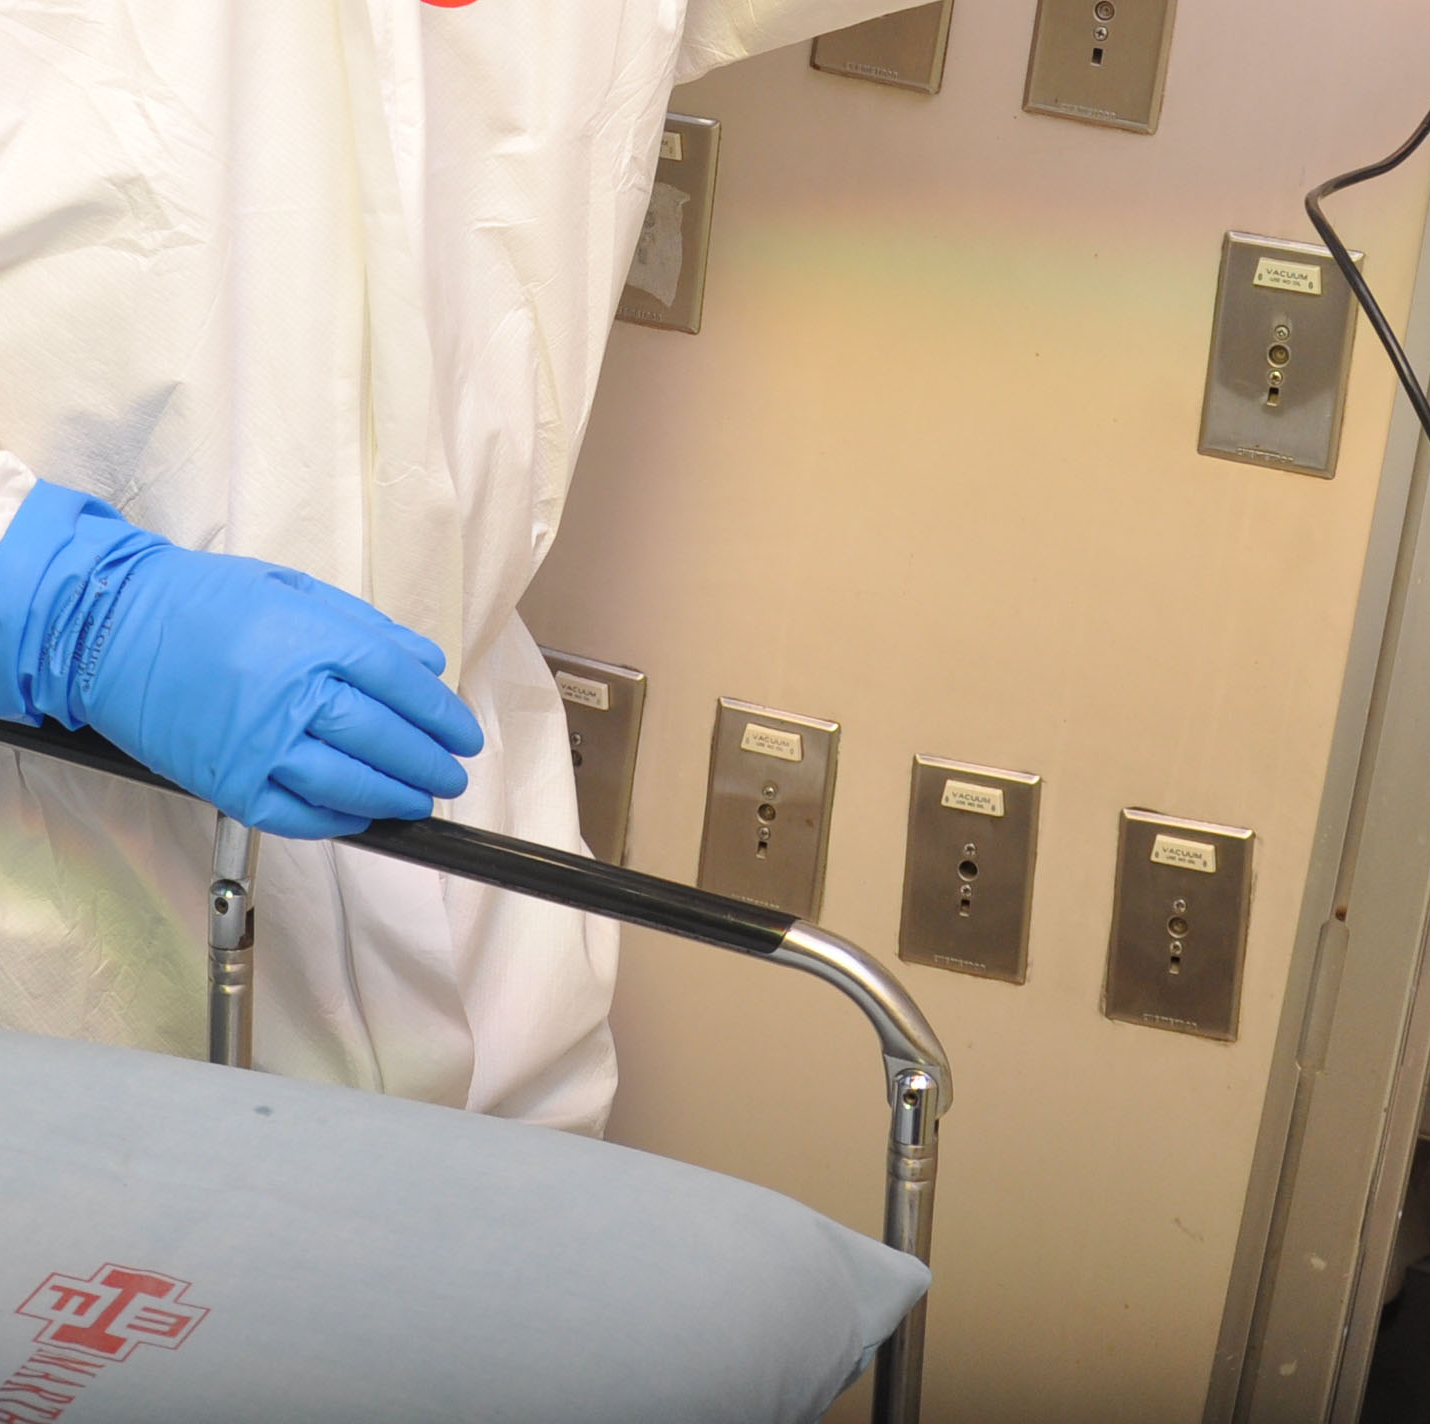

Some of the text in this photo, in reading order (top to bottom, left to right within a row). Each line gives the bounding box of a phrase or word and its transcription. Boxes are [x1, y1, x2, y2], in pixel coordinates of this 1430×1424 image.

[1266, 268, 1308, 280] VACUUM
[561, 682, 597, 699] VACUUM
[752, 733, 790, 747] VACUUM
[952, 791, 991, 805] VACUUM
[1162, 847, 1203, 860] VACUUM
